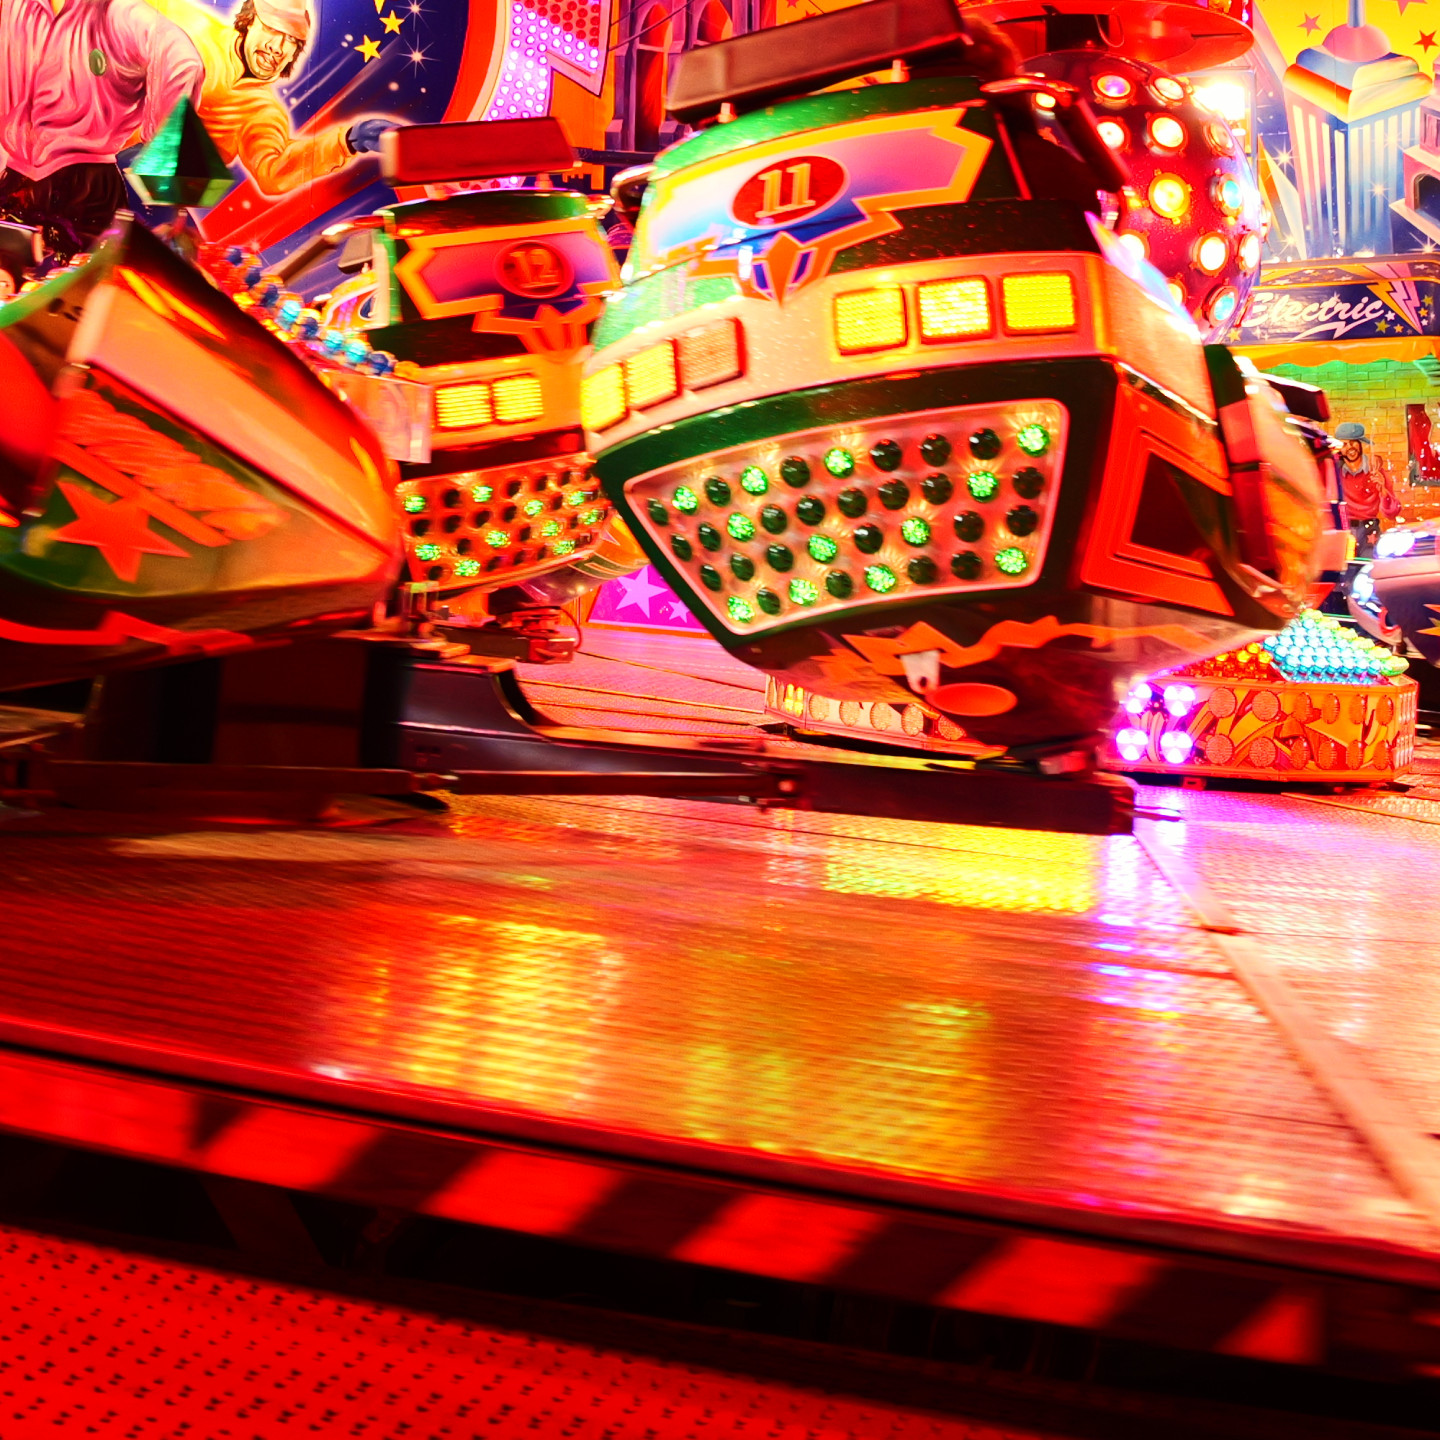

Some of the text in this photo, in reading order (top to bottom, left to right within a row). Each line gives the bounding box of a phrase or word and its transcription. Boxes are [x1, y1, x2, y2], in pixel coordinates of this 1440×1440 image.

[755, 162, 816, 218] 11
[509, 248, 560, 288] 12
[1242, 291, 1386, 340] Electric
